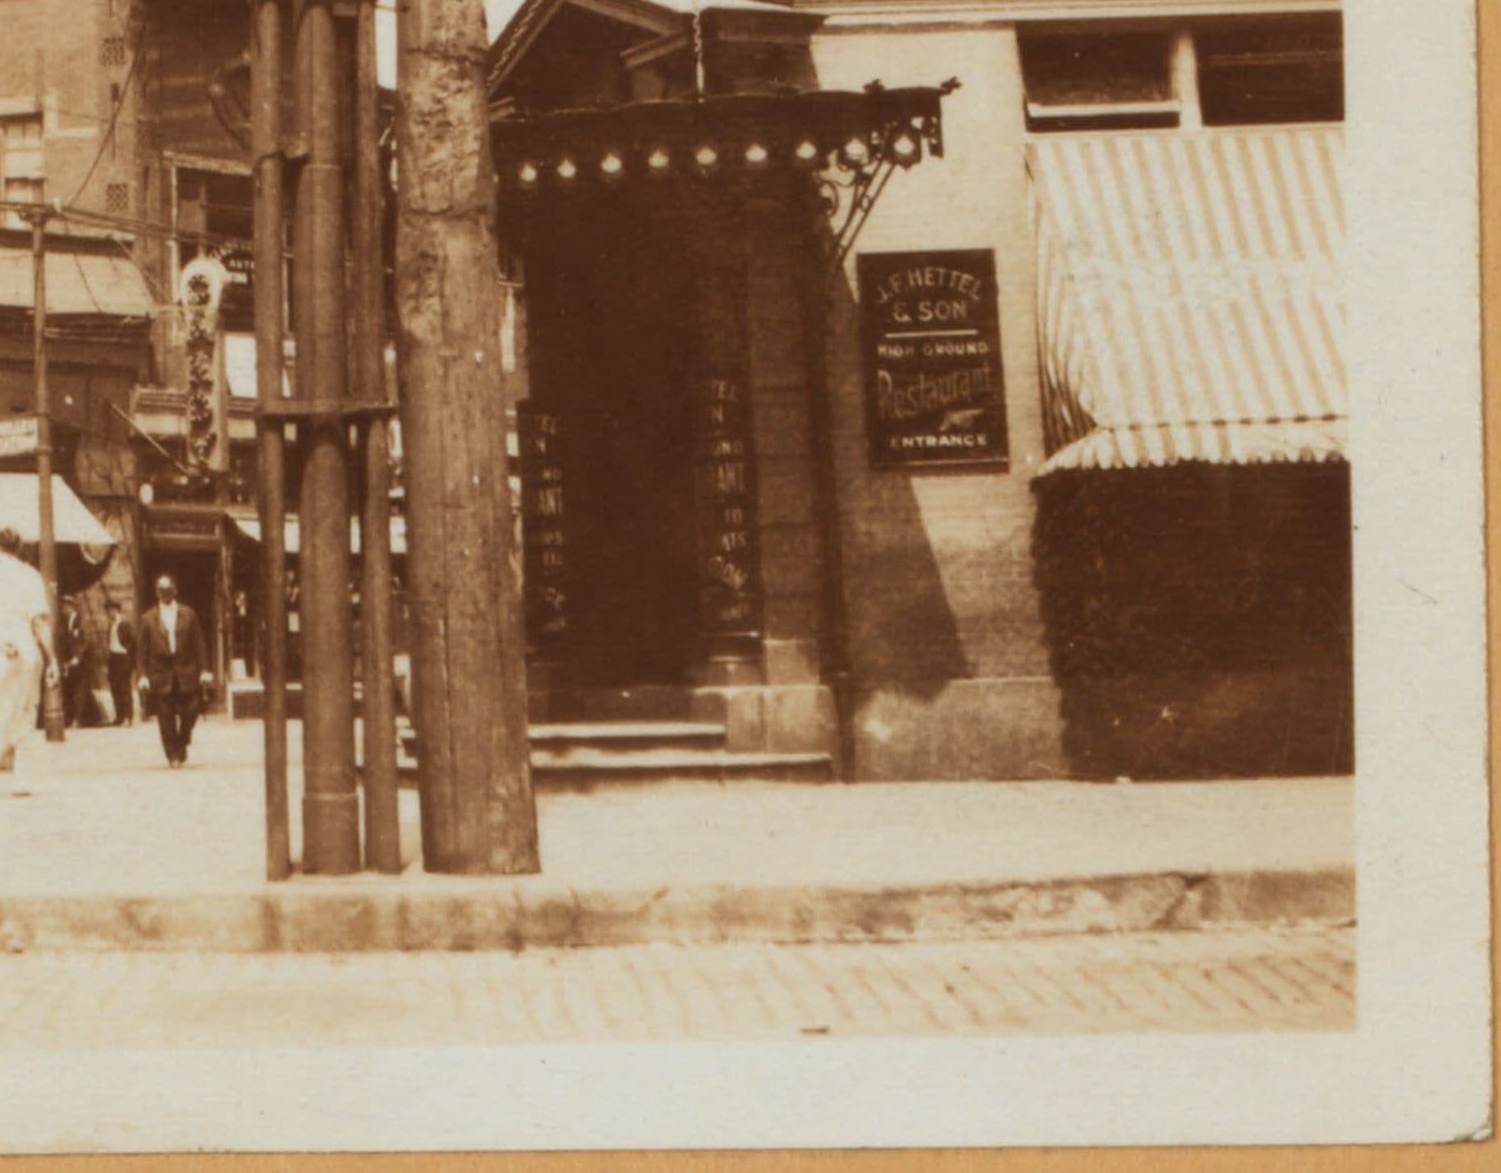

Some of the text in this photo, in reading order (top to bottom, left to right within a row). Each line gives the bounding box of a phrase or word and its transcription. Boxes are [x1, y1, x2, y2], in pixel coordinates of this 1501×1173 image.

[917, 300, 967, 321] SON
[922, 341, 989, 356] GROUND
[890, 432, 988, 449] ENTRANCE
